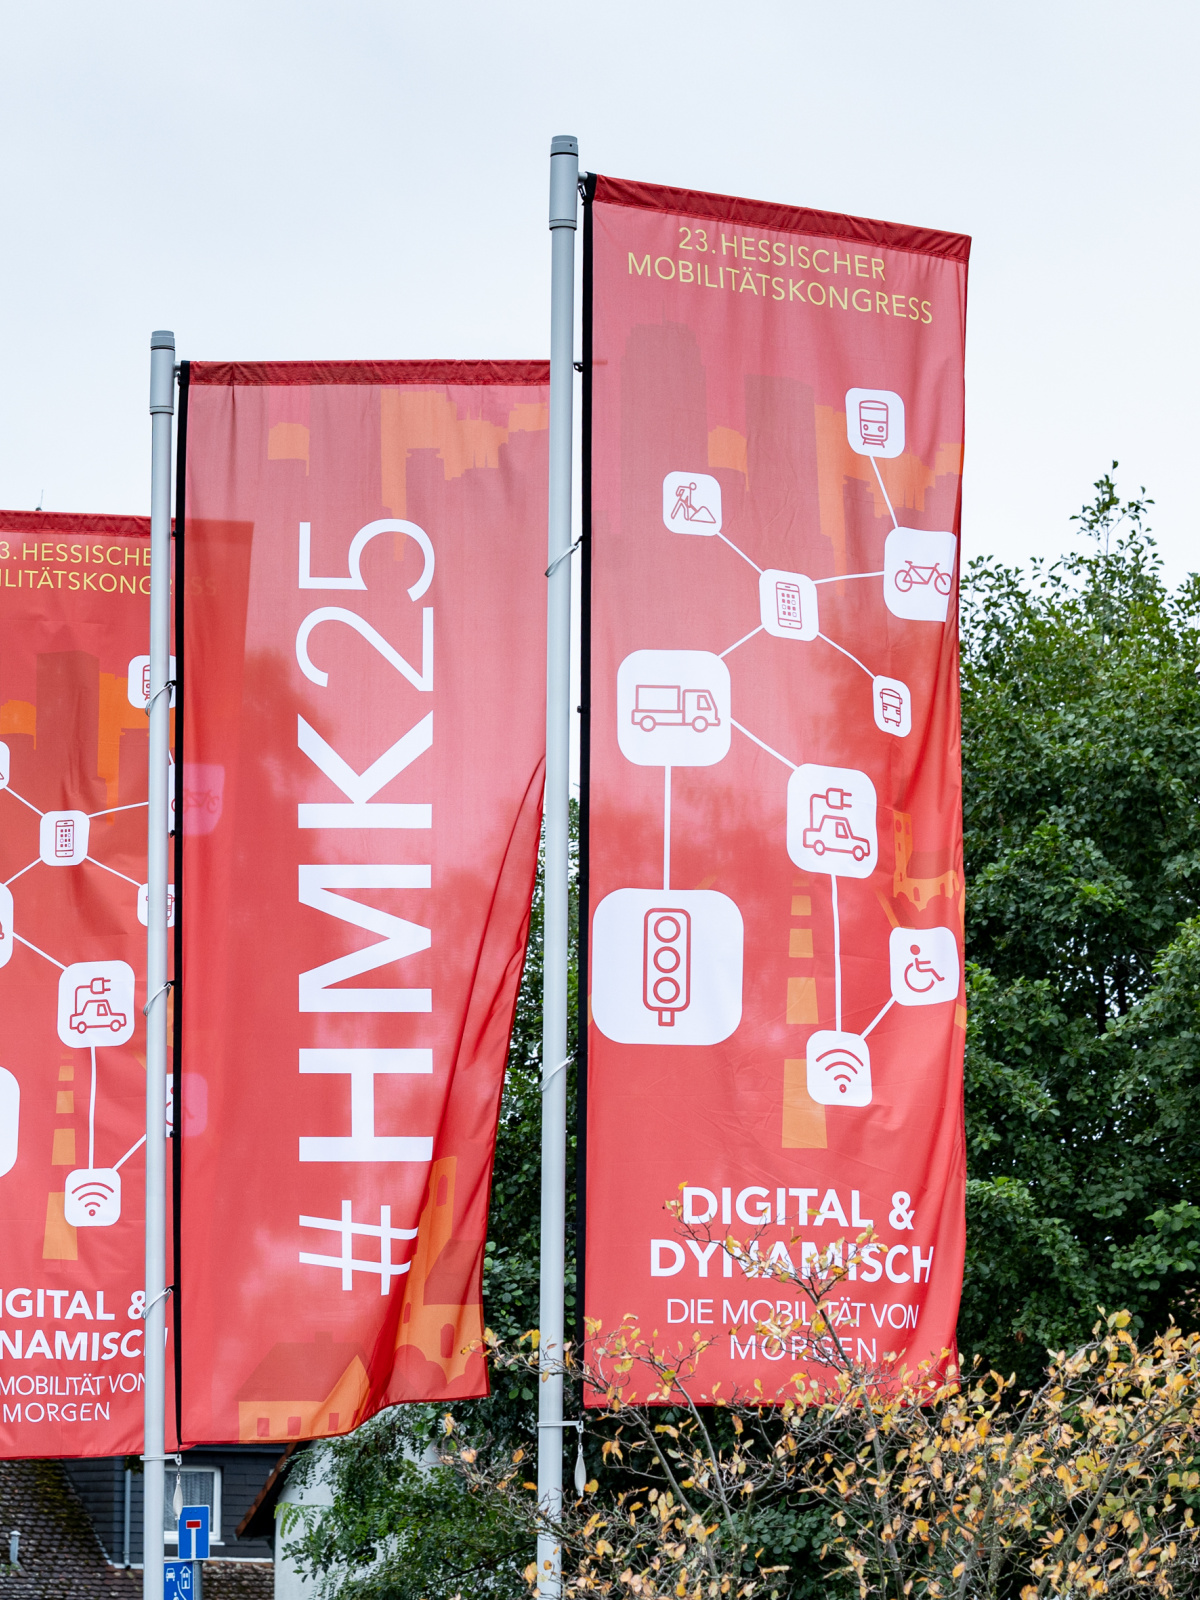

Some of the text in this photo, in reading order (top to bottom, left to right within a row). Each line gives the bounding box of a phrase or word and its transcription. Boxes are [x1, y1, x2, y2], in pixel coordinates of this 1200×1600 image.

[627, 252, 934, 325] MOBILITÄTSKONGRESS
[295, 518, 436, 1296] #HMK25
[683, 1186, 916, 1230] DIGITAL &
[650, 1238, 934, 1284] DYNAMISCH
[666, 1298, 714, 1324] DIE
[870, 1303, 919, 1329] VON
[2, 1401, 110, 1423] MORGEN
